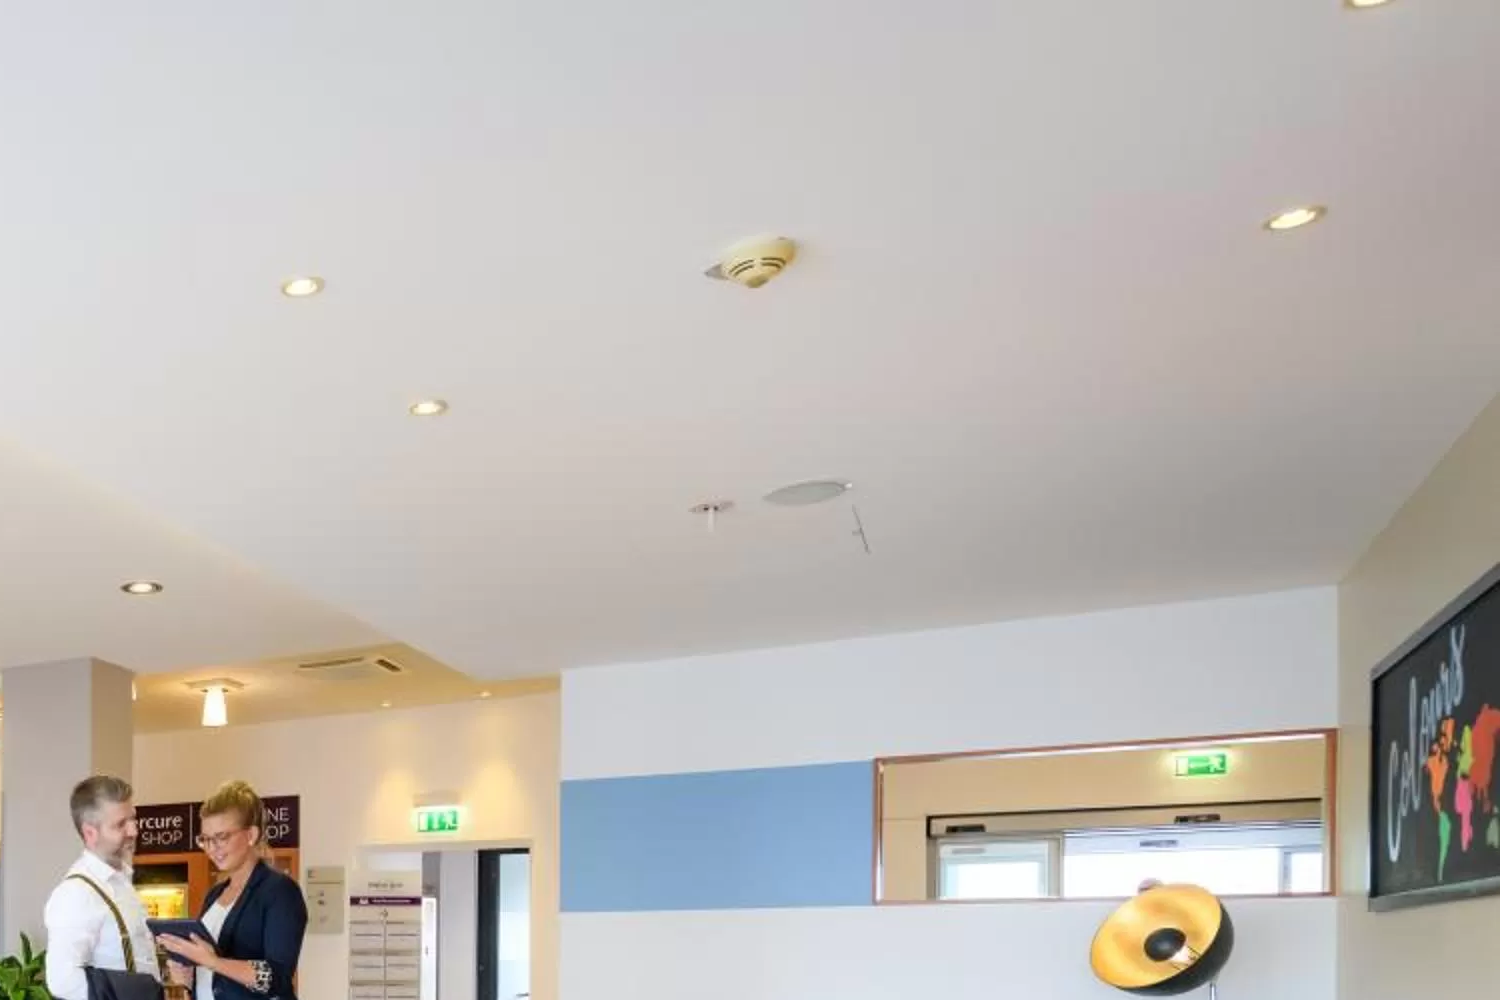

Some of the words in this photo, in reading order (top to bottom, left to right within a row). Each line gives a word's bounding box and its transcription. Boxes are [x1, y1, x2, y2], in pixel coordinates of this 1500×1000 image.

[135, 815, 184, 829] rcure
[141, 829, 184, 845] SHOP
[265, 824, 290, 839] OP
